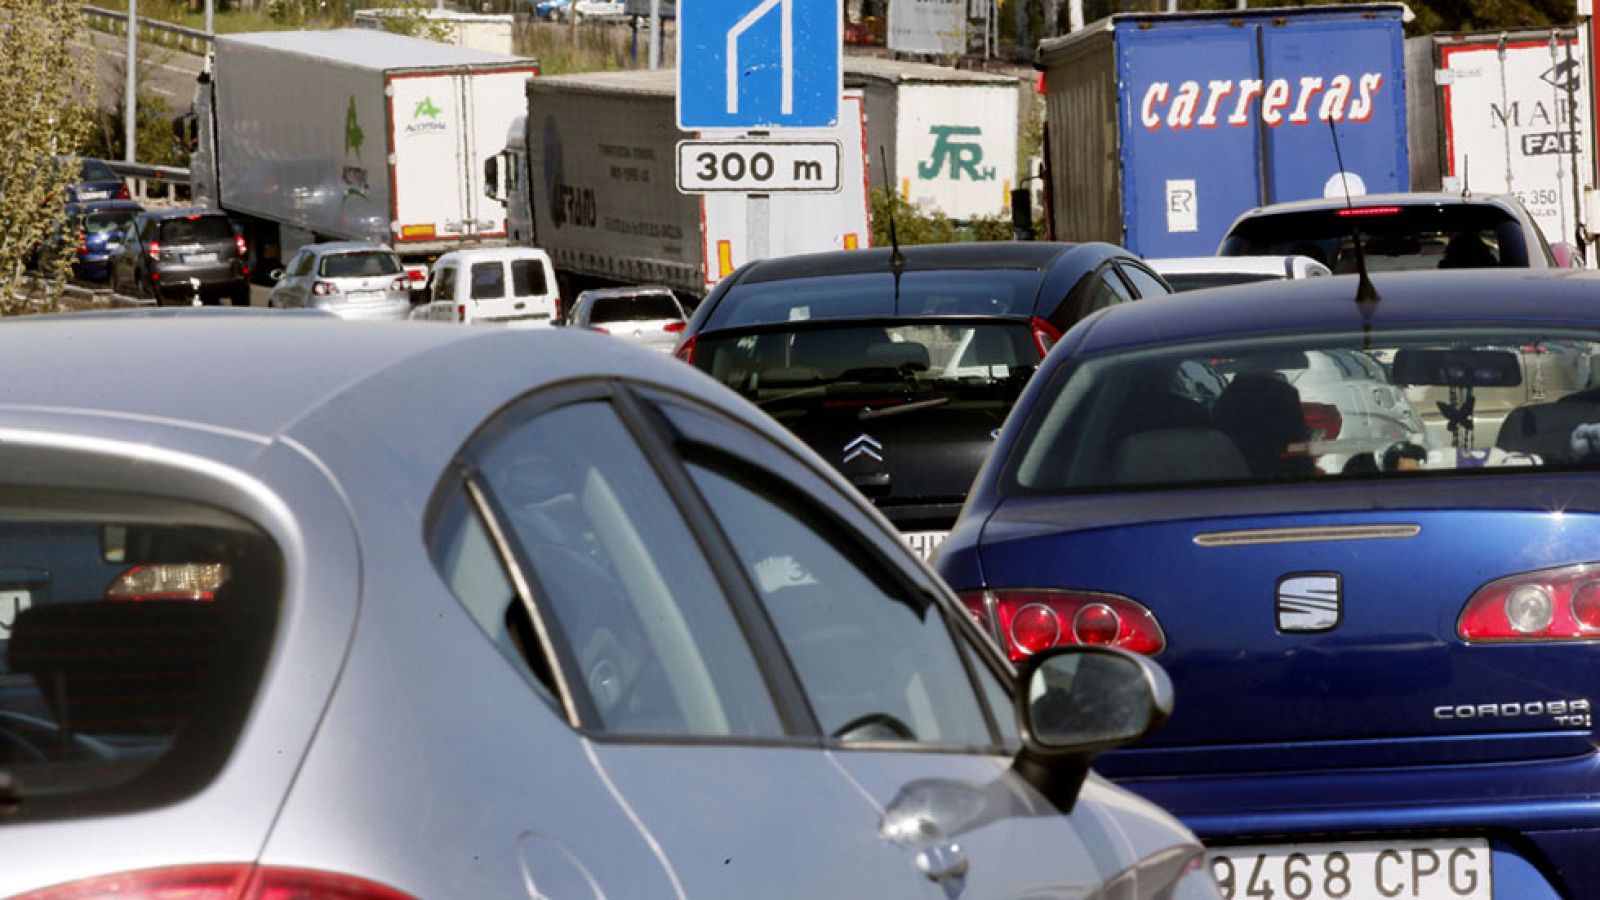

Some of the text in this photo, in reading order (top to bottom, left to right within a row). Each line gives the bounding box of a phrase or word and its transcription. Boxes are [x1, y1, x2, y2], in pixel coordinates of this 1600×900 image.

[1141, 72, 1383, 131] carreras
[696, 151, 822, 181] 300 m
[1530, 188, 1557, 204] 350
[1433, 698, 1590, 719] CORDOBA
[1208, 847, 1479, 900] 9468 CPG
